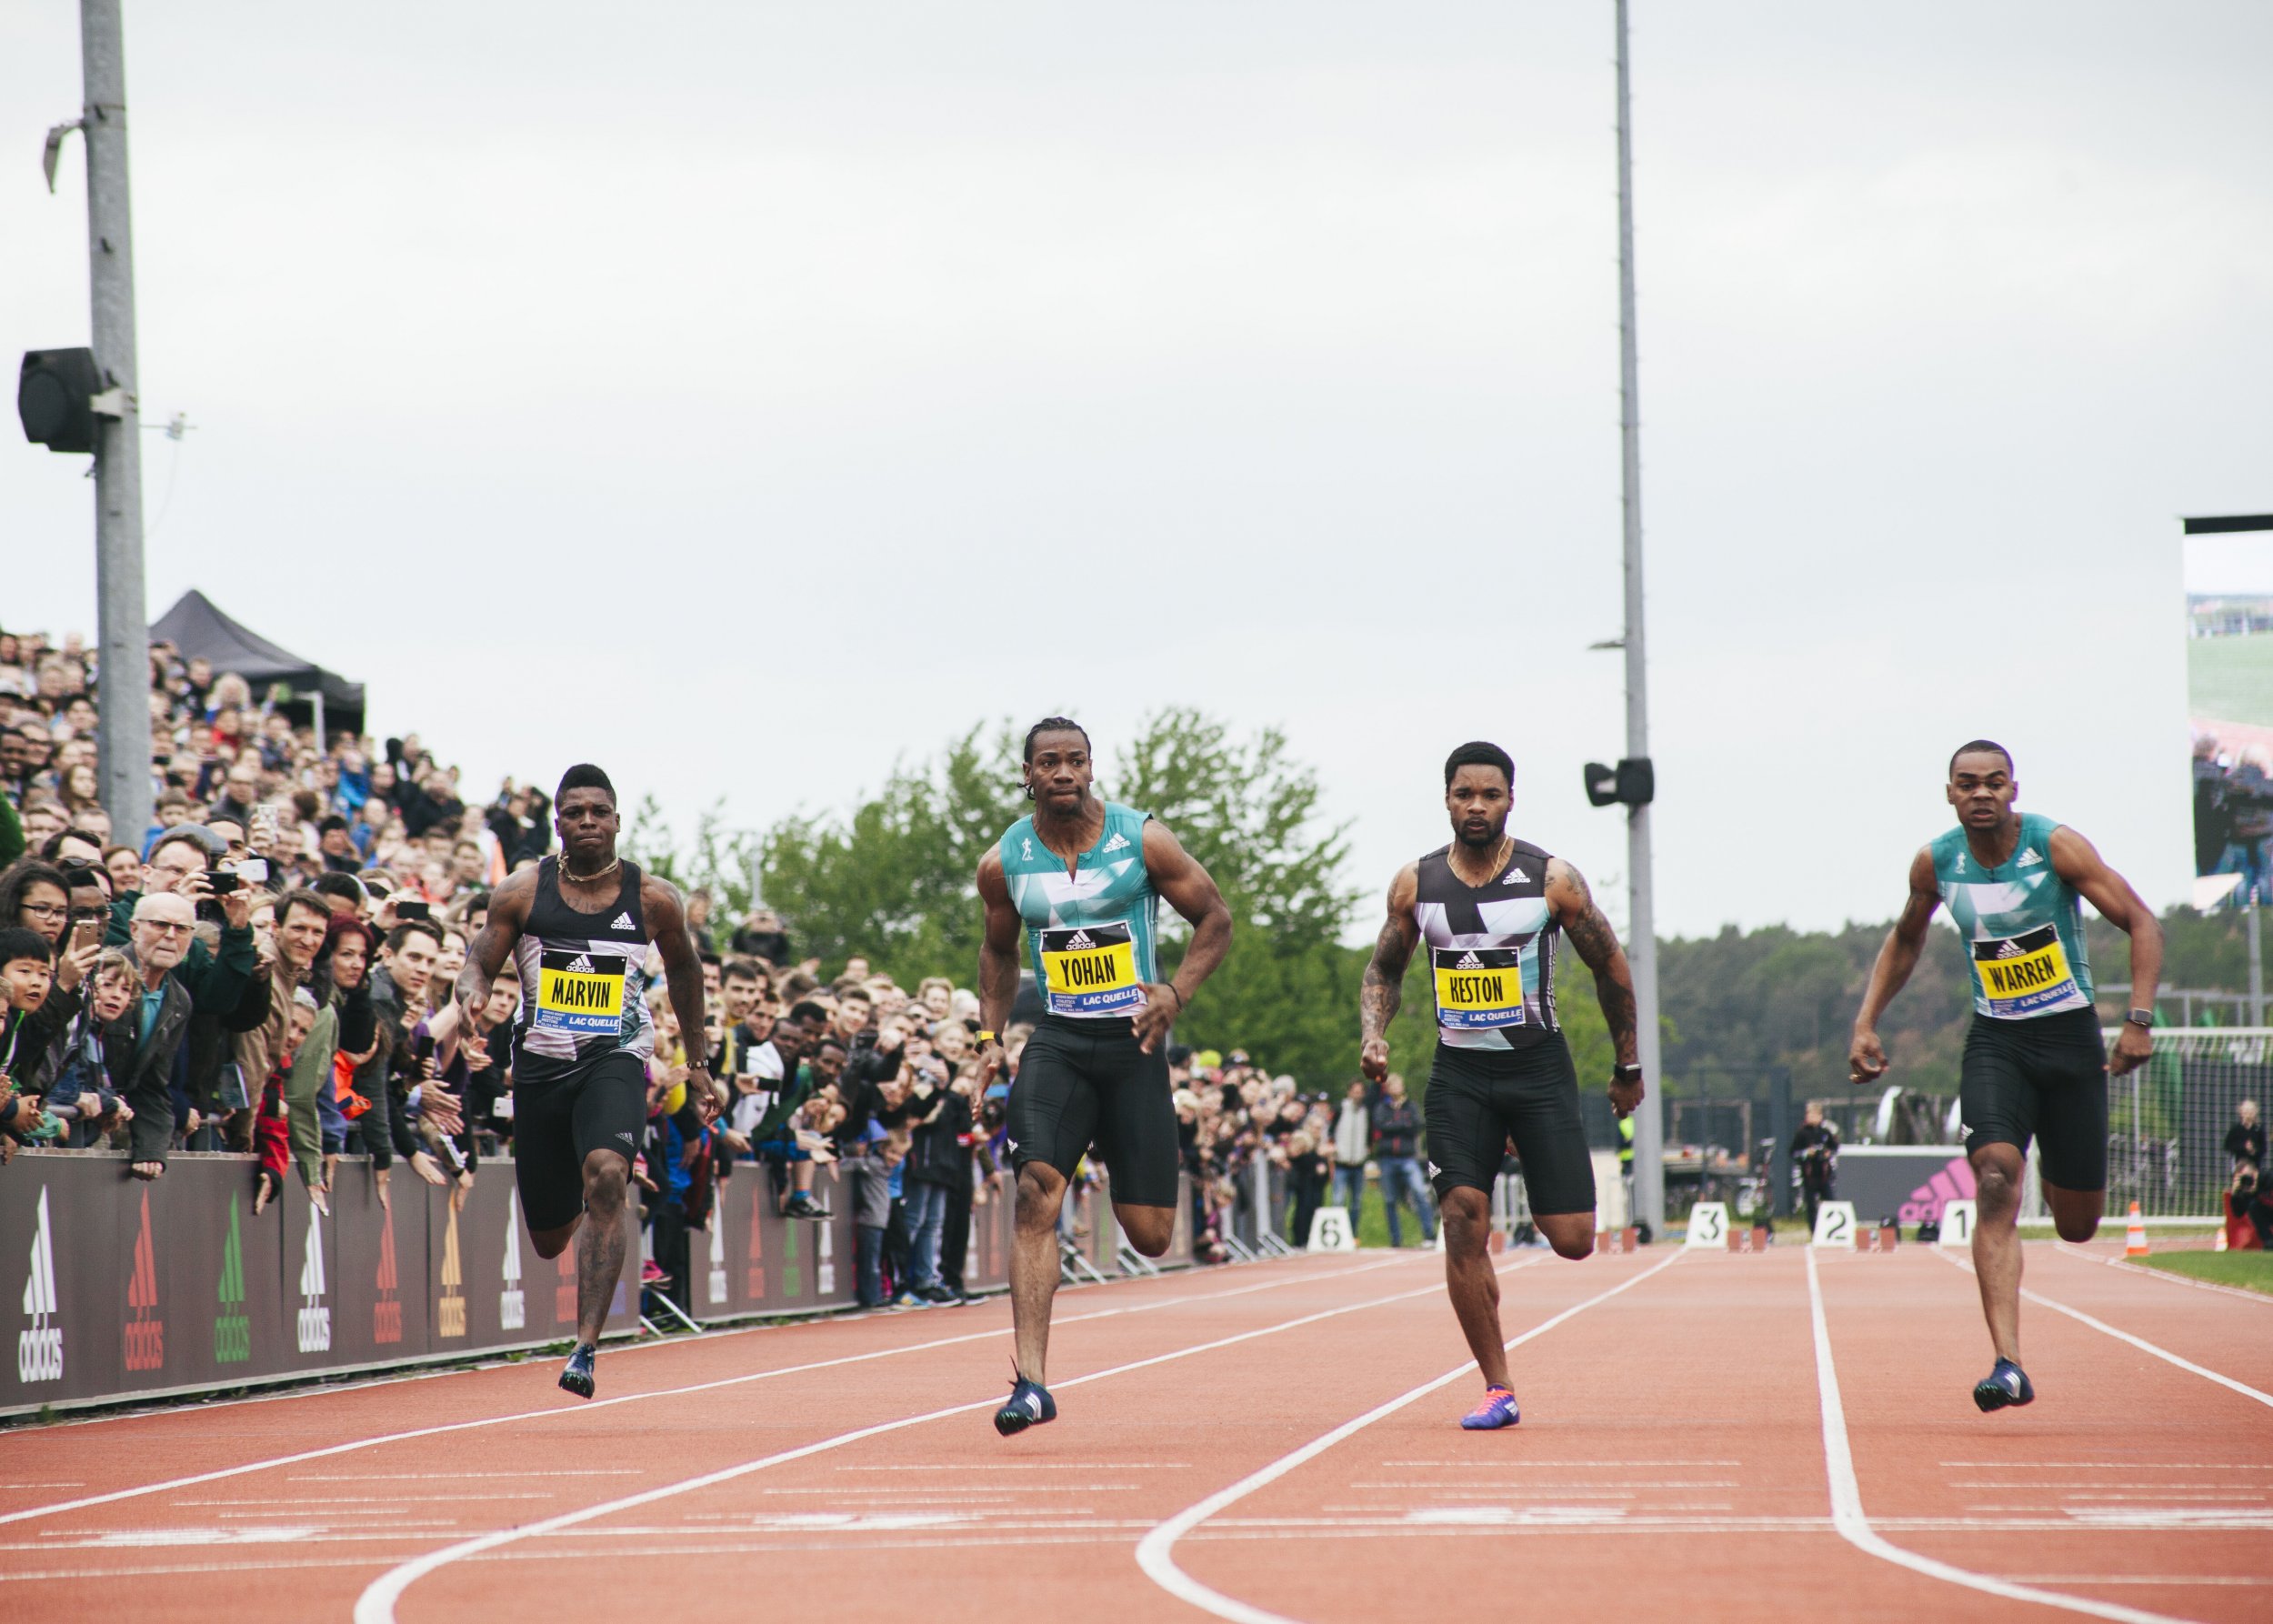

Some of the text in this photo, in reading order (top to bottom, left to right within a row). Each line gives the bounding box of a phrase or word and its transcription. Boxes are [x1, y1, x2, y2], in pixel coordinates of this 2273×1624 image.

[1502, 877, 1531, 885] adidas
[610, 922, 636, 931] adidas
[1066, 939, 1096, 951] adidas
[566, 965, 596, 974] adidas
[1060, 954, 1116, 987] YOHAN
[1456, 961, 1485, 970] adidas
[1988, 954, 2057, 993] WARREN
[551, 977, 611, 1008] MARVIN
[1083, 995, 1103, 1006] LAC
[1104, 988, 1138, 1004] QUELLE
[1449, 976, 1504, 1004] KESTON
[2019, 981, 2076, 1007] LAC QUELLE
[568, 1016, 619, 1028] LAC QUELLE
[1469, 1008, 1522, 1022] LAC QUELLE
[1321, 1218, 1340, 1248] 6
[1700, 1210, 1719, 1242] 3
[1827, 1209, 1847, 1239] 2
[1955, 1209, 1966, 1238] 1
[19, 1312, 63, 1383] adidas
